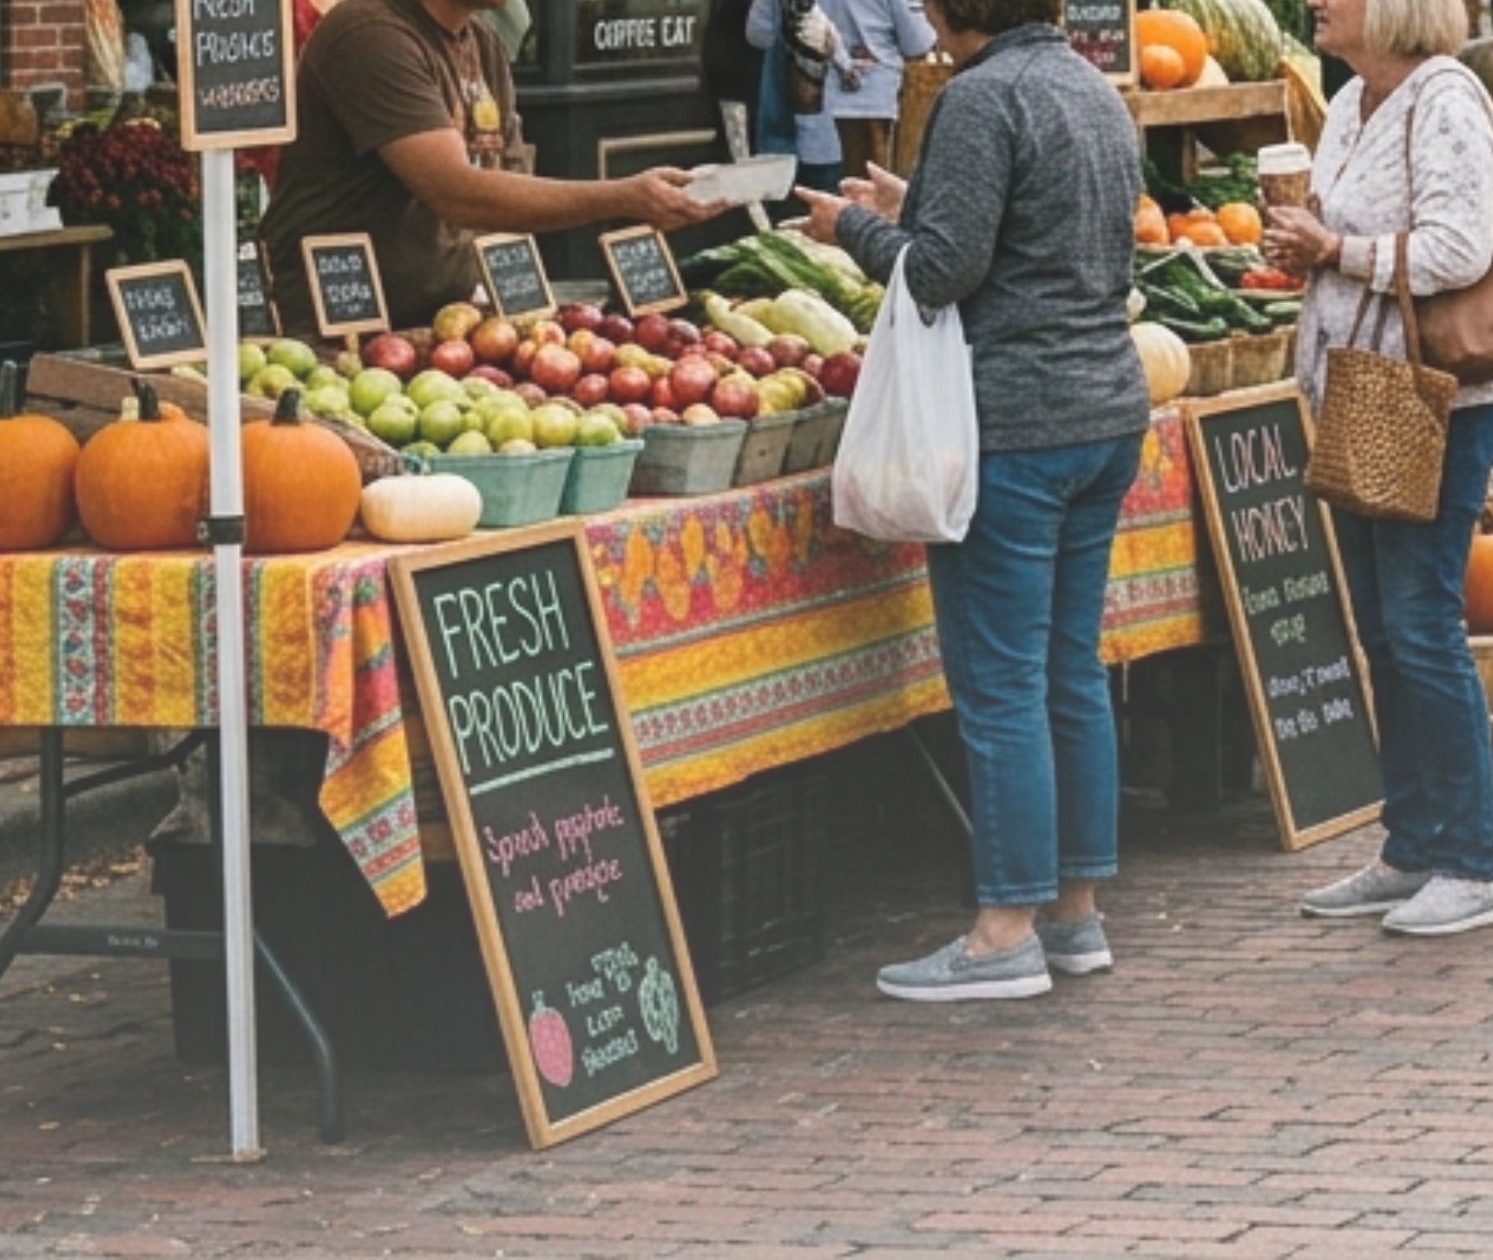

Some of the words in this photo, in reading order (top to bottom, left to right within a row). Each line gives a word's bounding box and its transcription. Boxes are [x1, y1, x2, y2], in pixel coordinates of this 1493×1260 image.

[1215, 423, 1299, 493] LOCAL
[1232, 494, 1310, 563] HONEY
[433, 569, 570, 678] FRESH
[448, 661, 609, 775] PRODUCE
